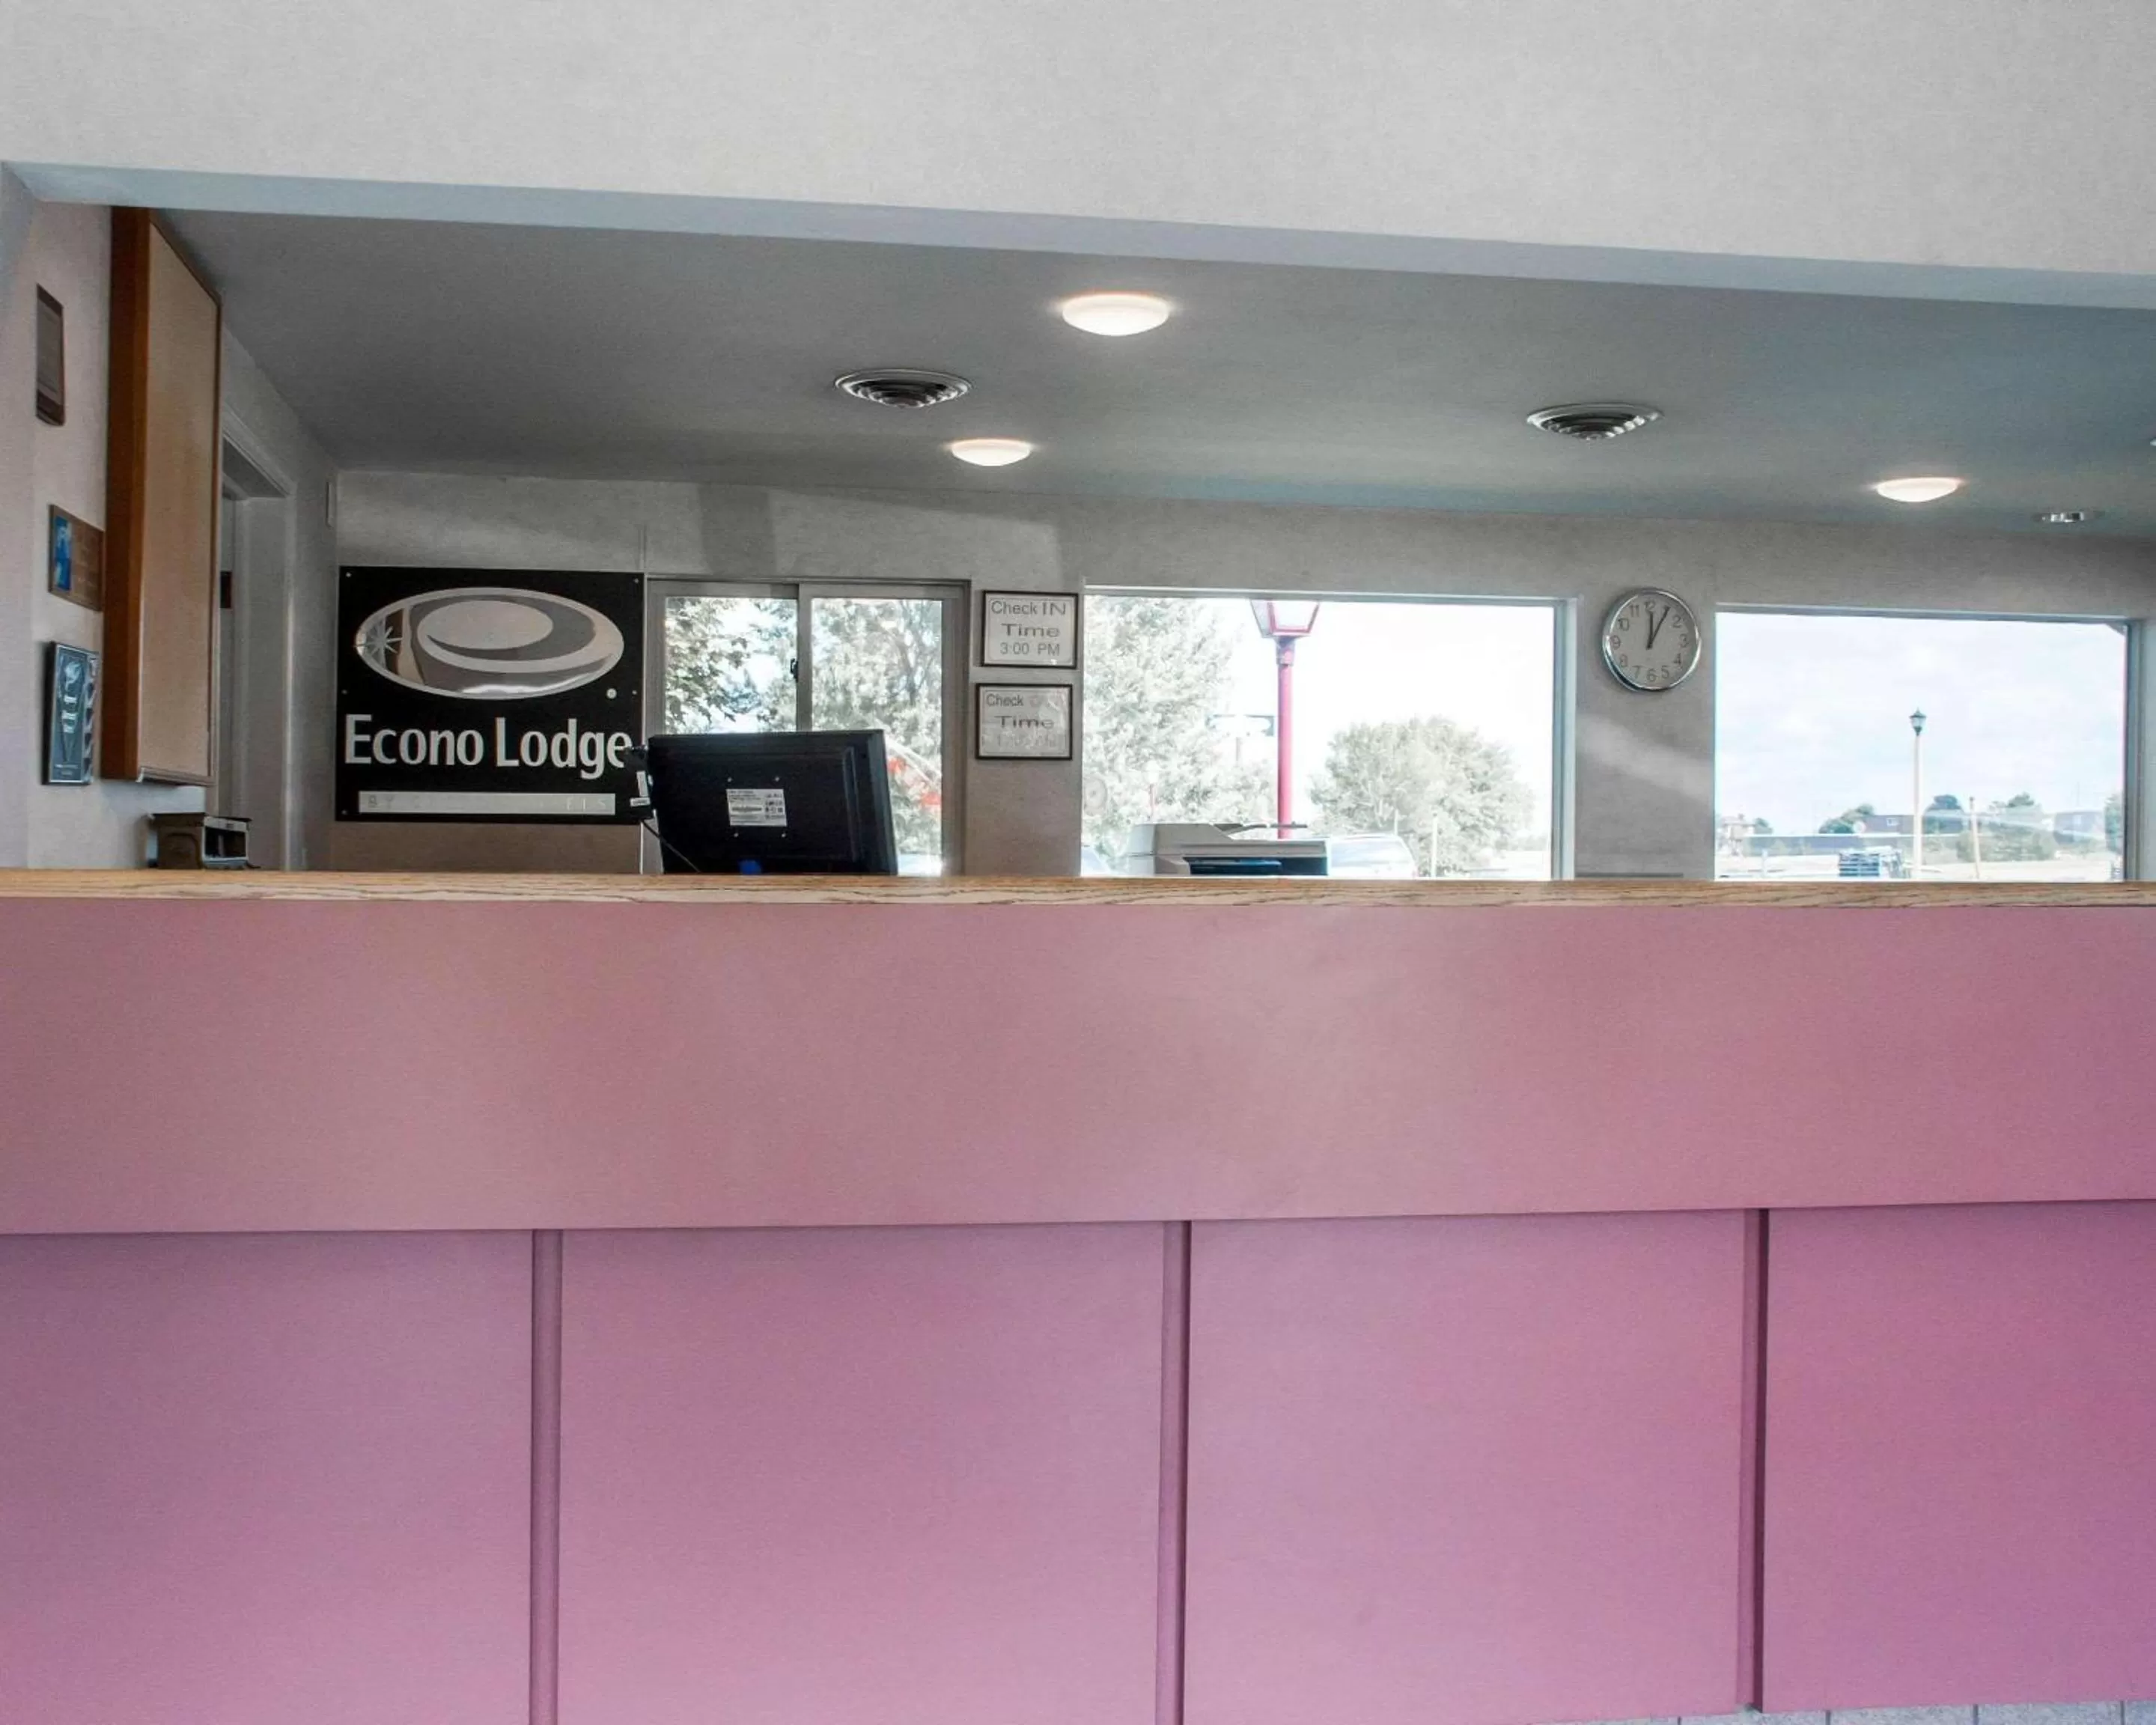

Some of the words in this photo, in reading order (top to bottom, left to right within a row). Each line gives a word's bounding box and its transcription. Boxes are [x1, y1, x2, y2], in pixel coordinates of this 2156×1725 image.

[990, 600, 1038, 615] Check
[1043, 602, 1066, 615] IN
[1001, 623, 1060, 637] Time
[1000, 642, 1029, 655] 3:00
[1038, 642, 1060, 656] PM
[986, 693, 1024, 707] Check
[994, 715, 1055, 728] Time
[344, 714, 484, 766] Econo
[495, 717, 633, 780] Lodge
